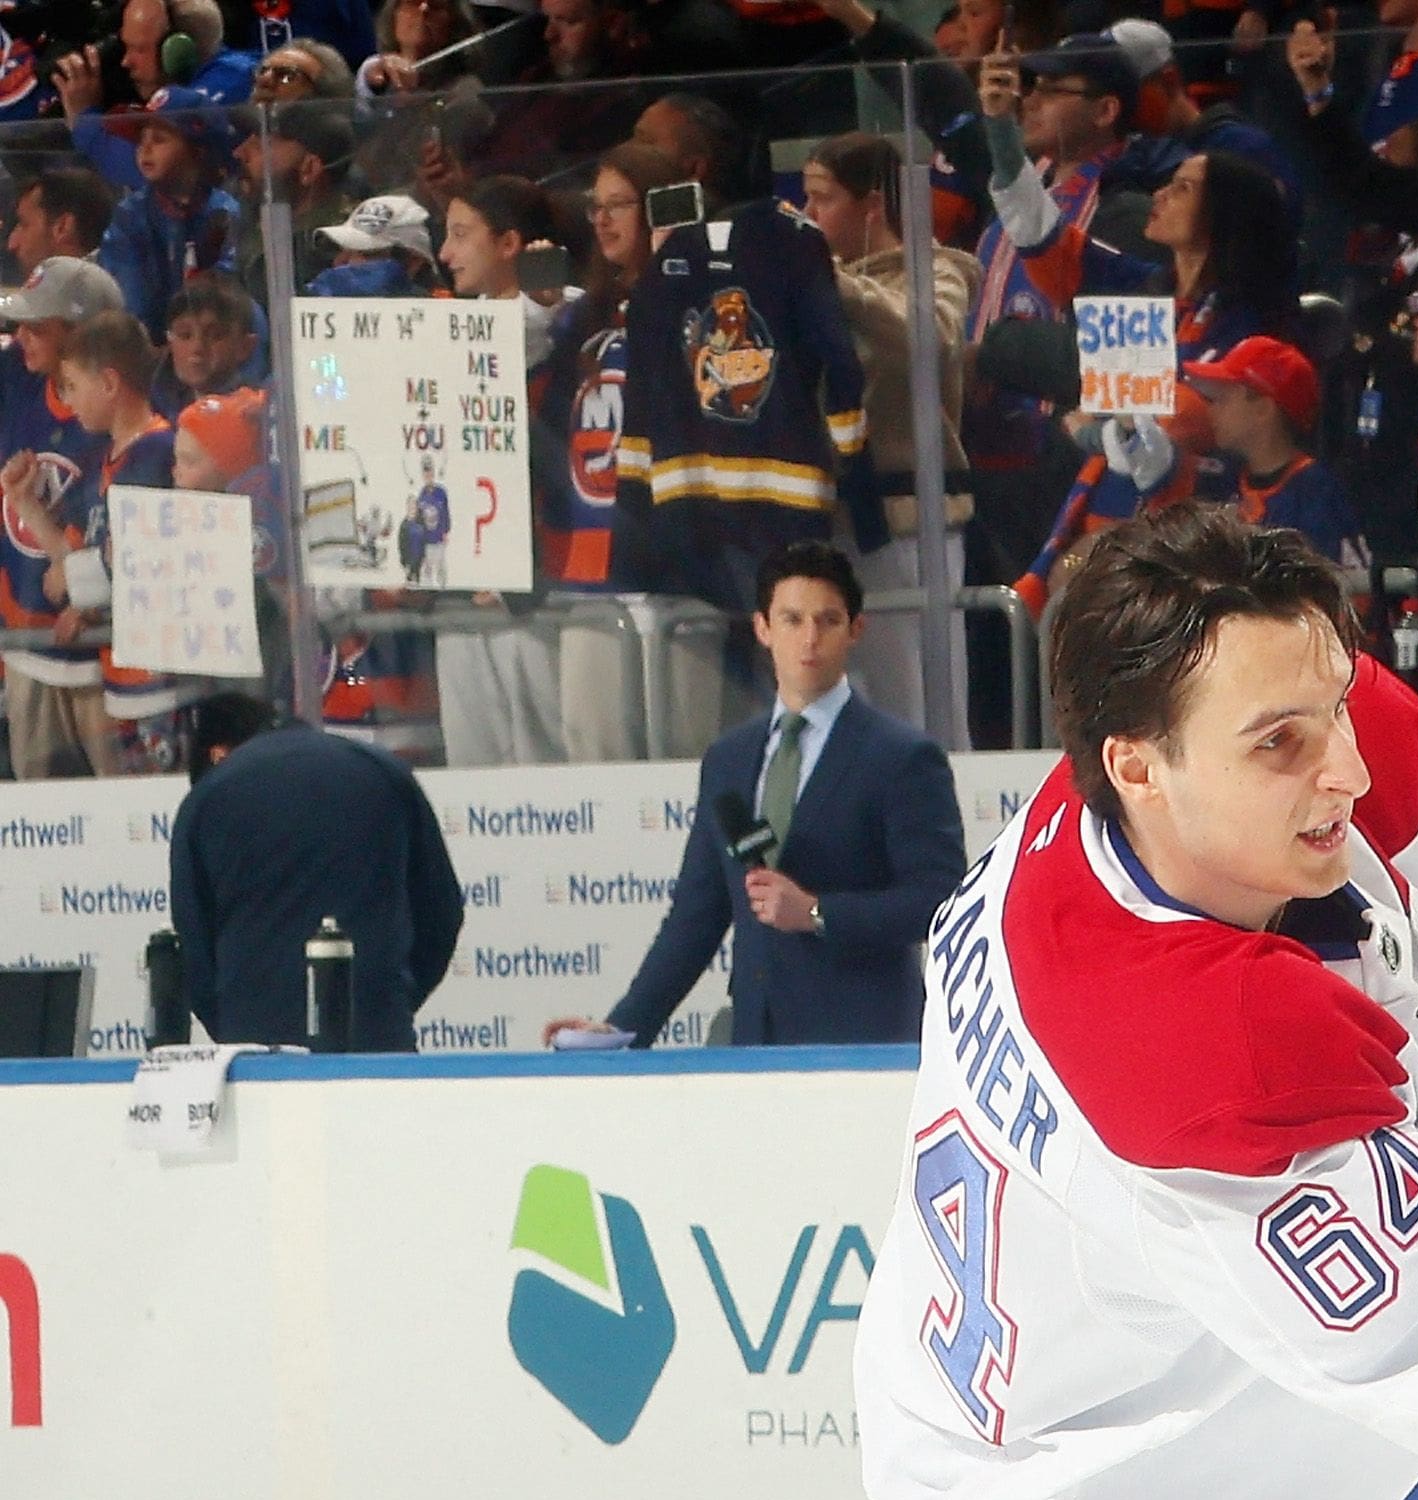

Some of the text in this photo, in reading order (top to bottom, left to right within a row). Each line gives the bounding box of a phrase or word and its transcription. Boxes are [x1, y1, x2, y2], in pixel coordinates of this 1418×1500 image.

[354, 312, 381, 339] MY
[1077, 302, 1168, 353] Stick
[468, 350, 499, 378] ME
[406, 377, 438, 405] ME
[459, 395, 516, 422] YOUR
[304, 424, 347, 451] ME
[403, 424, 445, 451] YOU
[462, 428, 516, 452] STICK
[468, 801, 594, 835] Northwell
[475, 944, 601, 977] Northwell
[415, 1013, 508, 1049] rthwell
